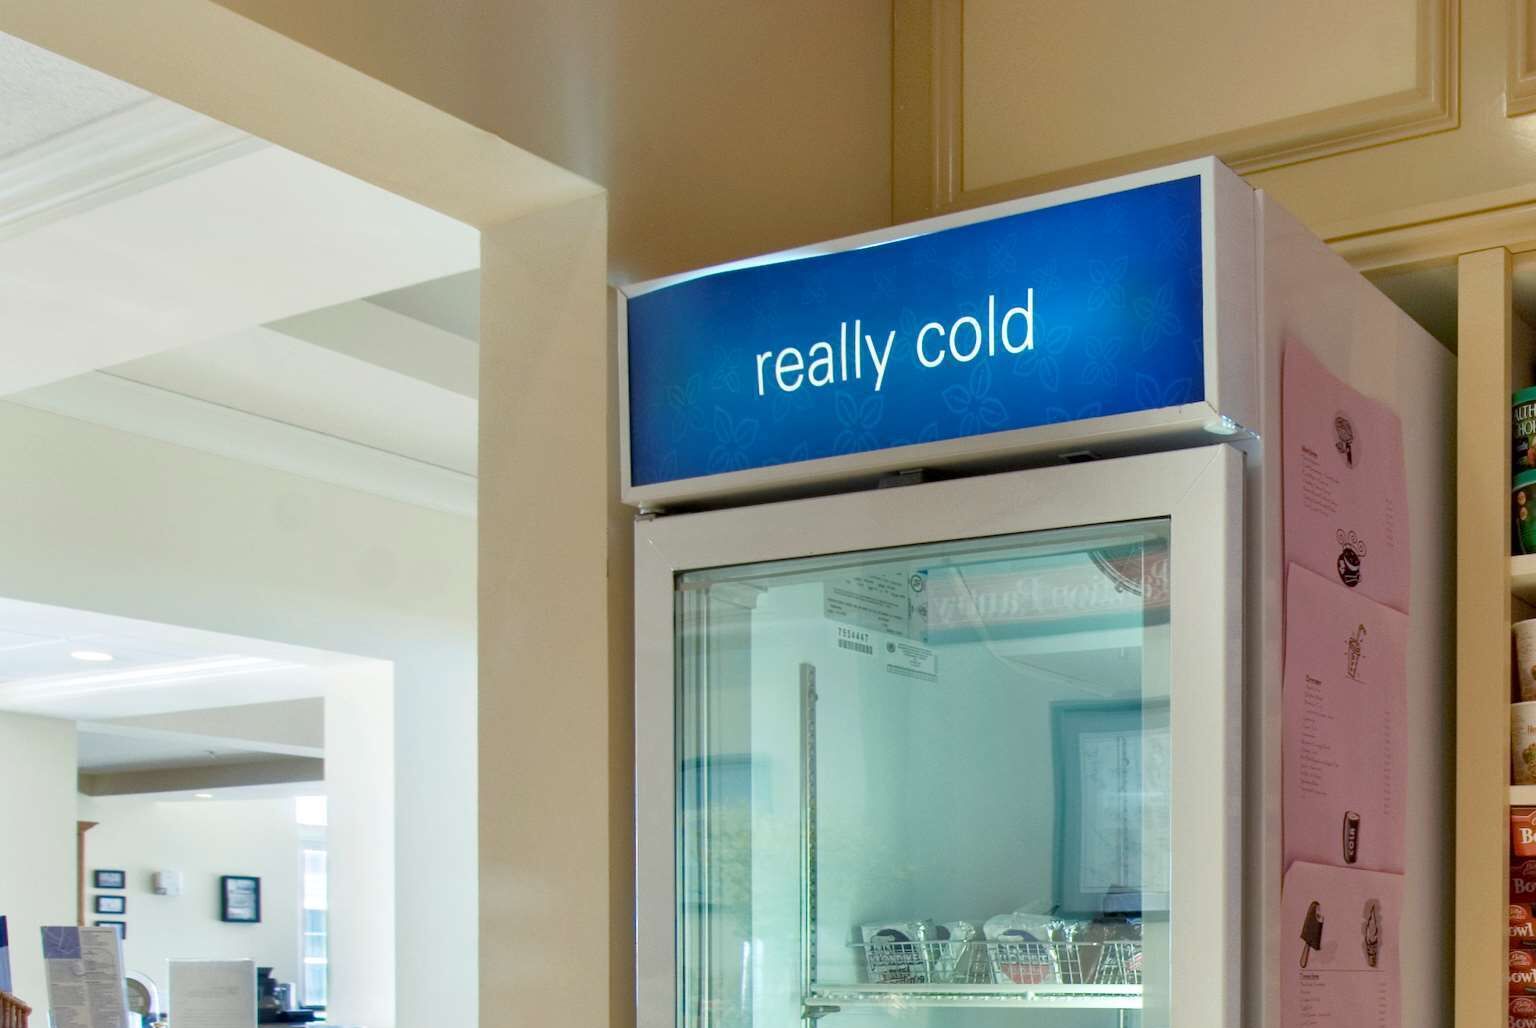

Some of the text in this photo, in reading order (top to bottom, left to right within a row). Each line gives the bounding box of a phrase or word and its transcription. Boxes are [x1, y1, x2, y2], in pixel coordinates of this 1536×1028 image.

[756, 287, 1034, 396] really cold
[1509, 922, 1534, 937] owl
